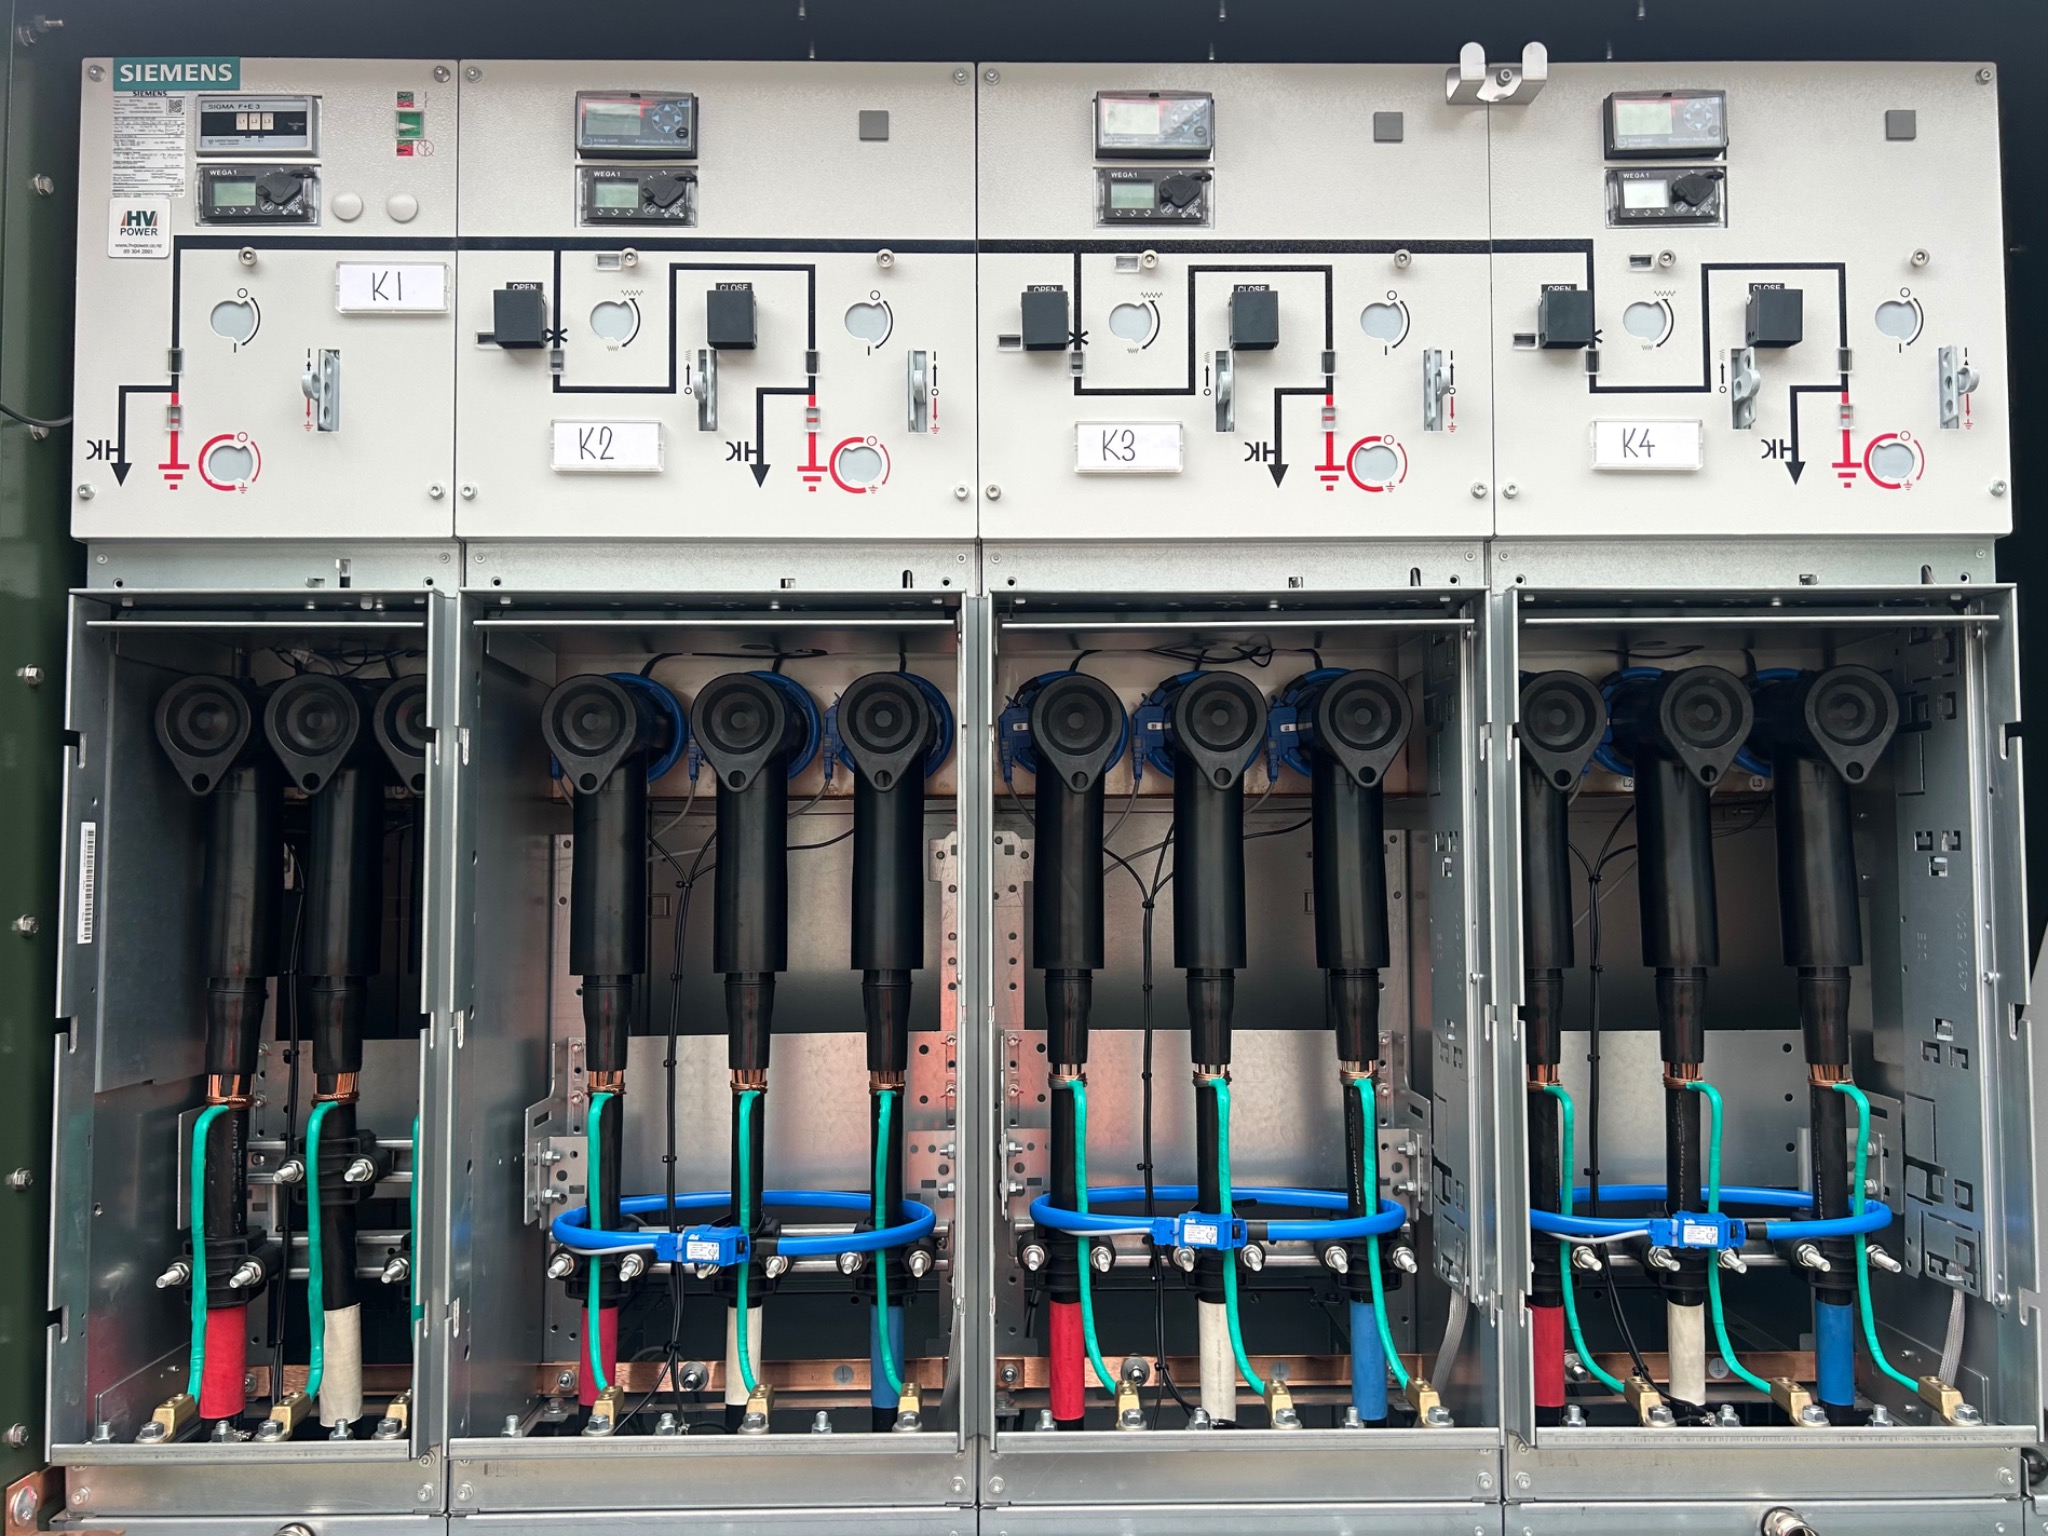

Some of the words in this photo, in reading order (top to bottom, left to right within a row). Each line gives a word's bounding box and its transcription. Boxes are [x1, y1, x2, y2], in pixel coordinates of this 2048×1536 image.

[120, 63, 233, 82] SIEMENS
[127, 210, 157, 226] HV
[120, 228, 158, 236] POWER
[372, 271, 402, 301] K1
[579, 426, 614, 460] K2
[1102, 429, 1136, 461] K3
[1623, 427, 1656, 458] K4
[1623, 779, 1633, 787] L2
[1753, 779, 1763, 787] L3
